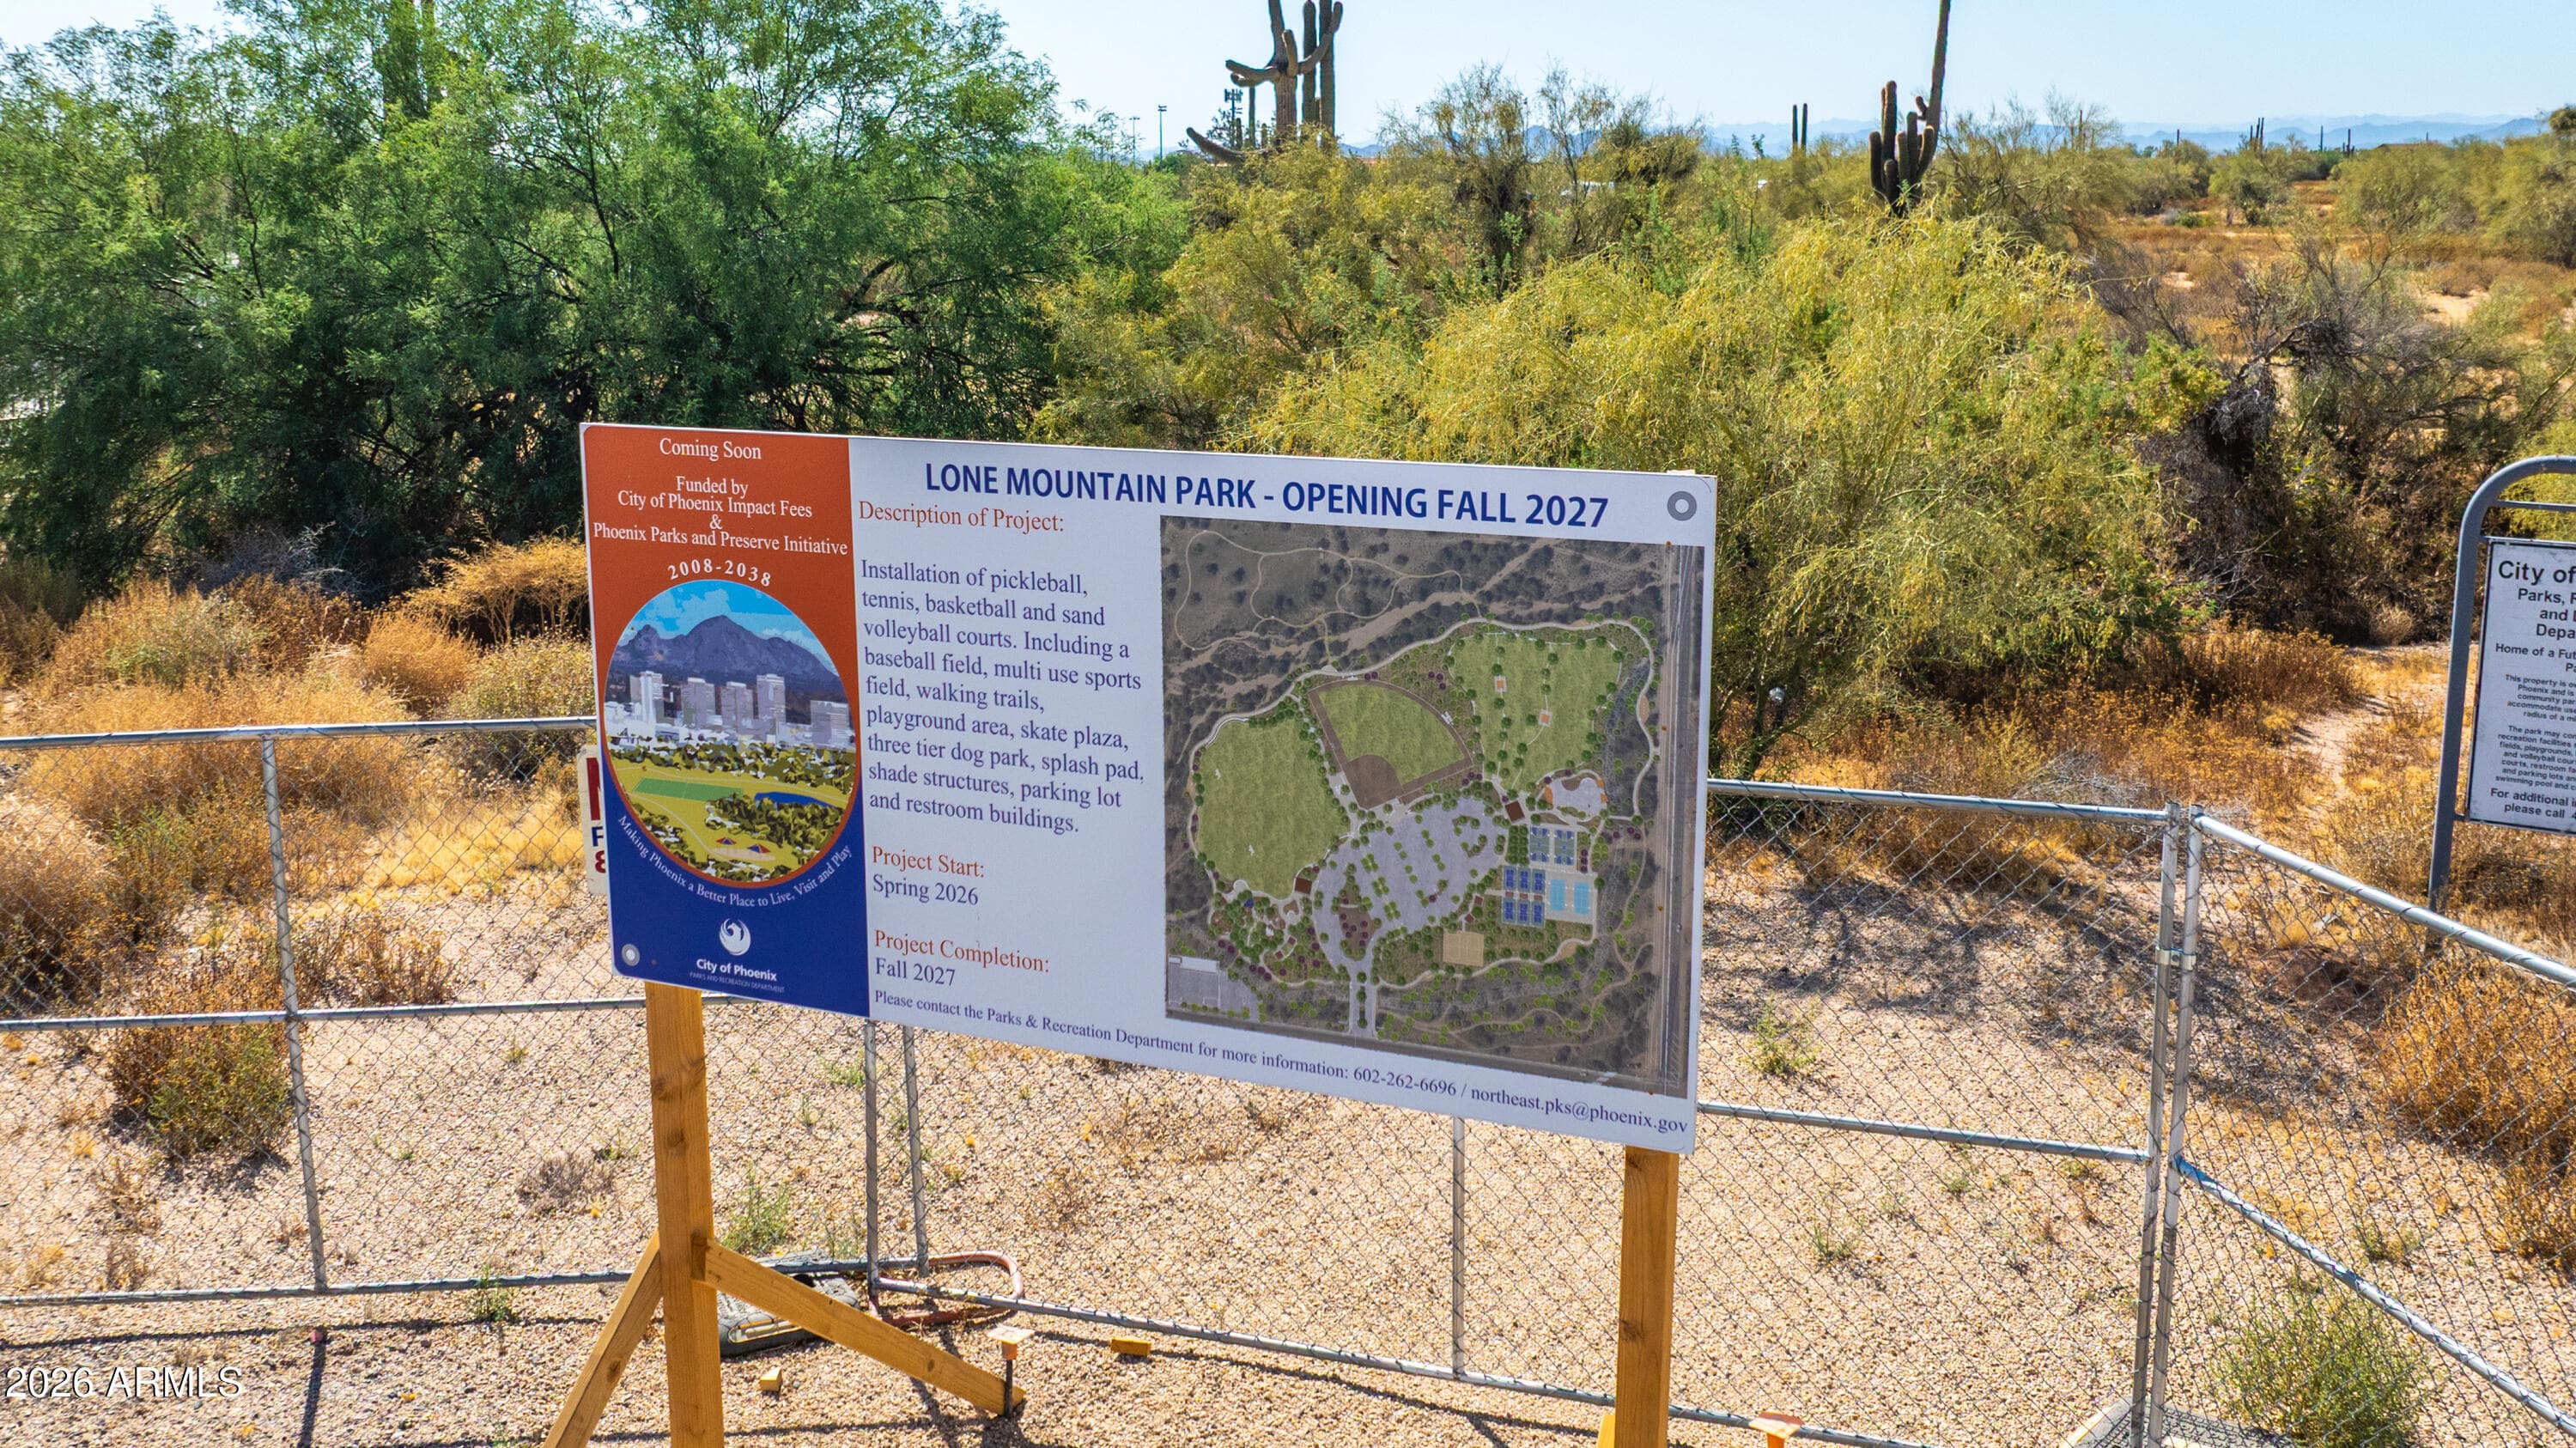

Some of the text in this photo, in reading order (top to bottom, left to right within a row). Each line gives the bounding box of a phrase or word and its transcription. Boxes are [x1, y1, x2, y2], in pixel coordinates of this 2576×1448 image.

[659, 438, 762, 461] Coming Soon
[676, 476, 749, 498] Funded by
[926, 463, 999, 494] LONE
[1007, 467, 1165, 504] MOUNTAIN
[1177, 476, 1256, 508] PARK
[1282, 481, 1426, 518] OPENING
[1438, 490, 1516, 523] FALL
[1526, 495, 1608, 527] 2027
[618, 490, 811, 517] City of Phoenix Impact Fees
[709, 514, 722, 530] &
[859, 501, 1064, 534] Description of Project:
[593, 523, 848, 556] Phoenix Parks and Preserve Initiative
[861, 559, 1088, 596] Installation of pickleball,
[2499, 561, 2576, 585] City of
[862, 591, 1105, 626] tennis, basketball and sand
[2518, 588, 2564, 605] Parks,
[2540, 609, 2568, 620] and
[863, 620, 1130, 661] volleyball courts. Including a
[2496, 643, 2528, 654] Home
[866, 647, 934, 671] baseball
[943, 653, 987, 678] field,
[994, 660, 1042, 680] multi
[1085, 671, 1140, 691] sports
[2523, 678, 2557, 686] property
[866, 676, 1044, 713] field, walking trails,
[2518, 684, 2549, 693] Phoenix
[2518, 694, 2560, 703] community
[2507, 702, 2561, 711] accommodate
[866, 705, 1128, 751] playground area, skate plaza,
[868, 733, 910, 754] three
[917, 739, 945, 758] tier
[951, 742, 984, 767] dog
[990, 749, 1035, 772] park,
[1042, 754, 1098, 776] splash
[2540, 738, 2571, 746] facilities
[2520, 753, 2555, 762] volleyball
[869, 763, 1121, 809] shade structures, parking lot
[2496, 776, 2533, 786] swimming
[2518, 770, 2547, 779] parking
[2491, 788, 2509, 798] For
[2513, 793, 2568, 806] additional
[2504, 803, 2541, 815] please
[2545, 809, 2565, 818] call
[870, 792, 1078, 835] and restroom buildings.
[617, 816, 648, 858] Making
[649, 852, 687, 887] Phoenix
[688, 882, 694, 891] a
[696, 885, 726, 903] Better
[730, 893, 755, 907] Place
[757, 896, 768, 906] to
[794, 879, 818, 896] Visit
[817, 864, 835, 883] and
[831, 844, 854, 873] Play
[872, 846, 984, 878] Project Start:
[872, 873, 978, 906] Spring 2026
[874, 929, 1049, 973] Project Completion:
[696, 958, 776, 981] City of Phoenix
[876, 957, 956, 987] Fall 2027
[875, 990, 913, 1008] Please
[917, 996, 961, 1016] contact
[964, 1005, 982, 1019] the
[987, 1007, 1021, 1026] Parks
[1025, 1014, 1037, 1028] &
[1042, 1016, 1111, 1041] Recreation
[1116, 1028, 1194, 1055] Department
[1198, 1041, 1218, 1056] for
[1222, 1047, 1256, 1063] more
[1261, 1051, 1348, 1079] information:
[1353, 1068, 1456, 1096] 602-262-6696
[1471, 1087, 1687, 1135] northeast.pks@phoenix.gov
